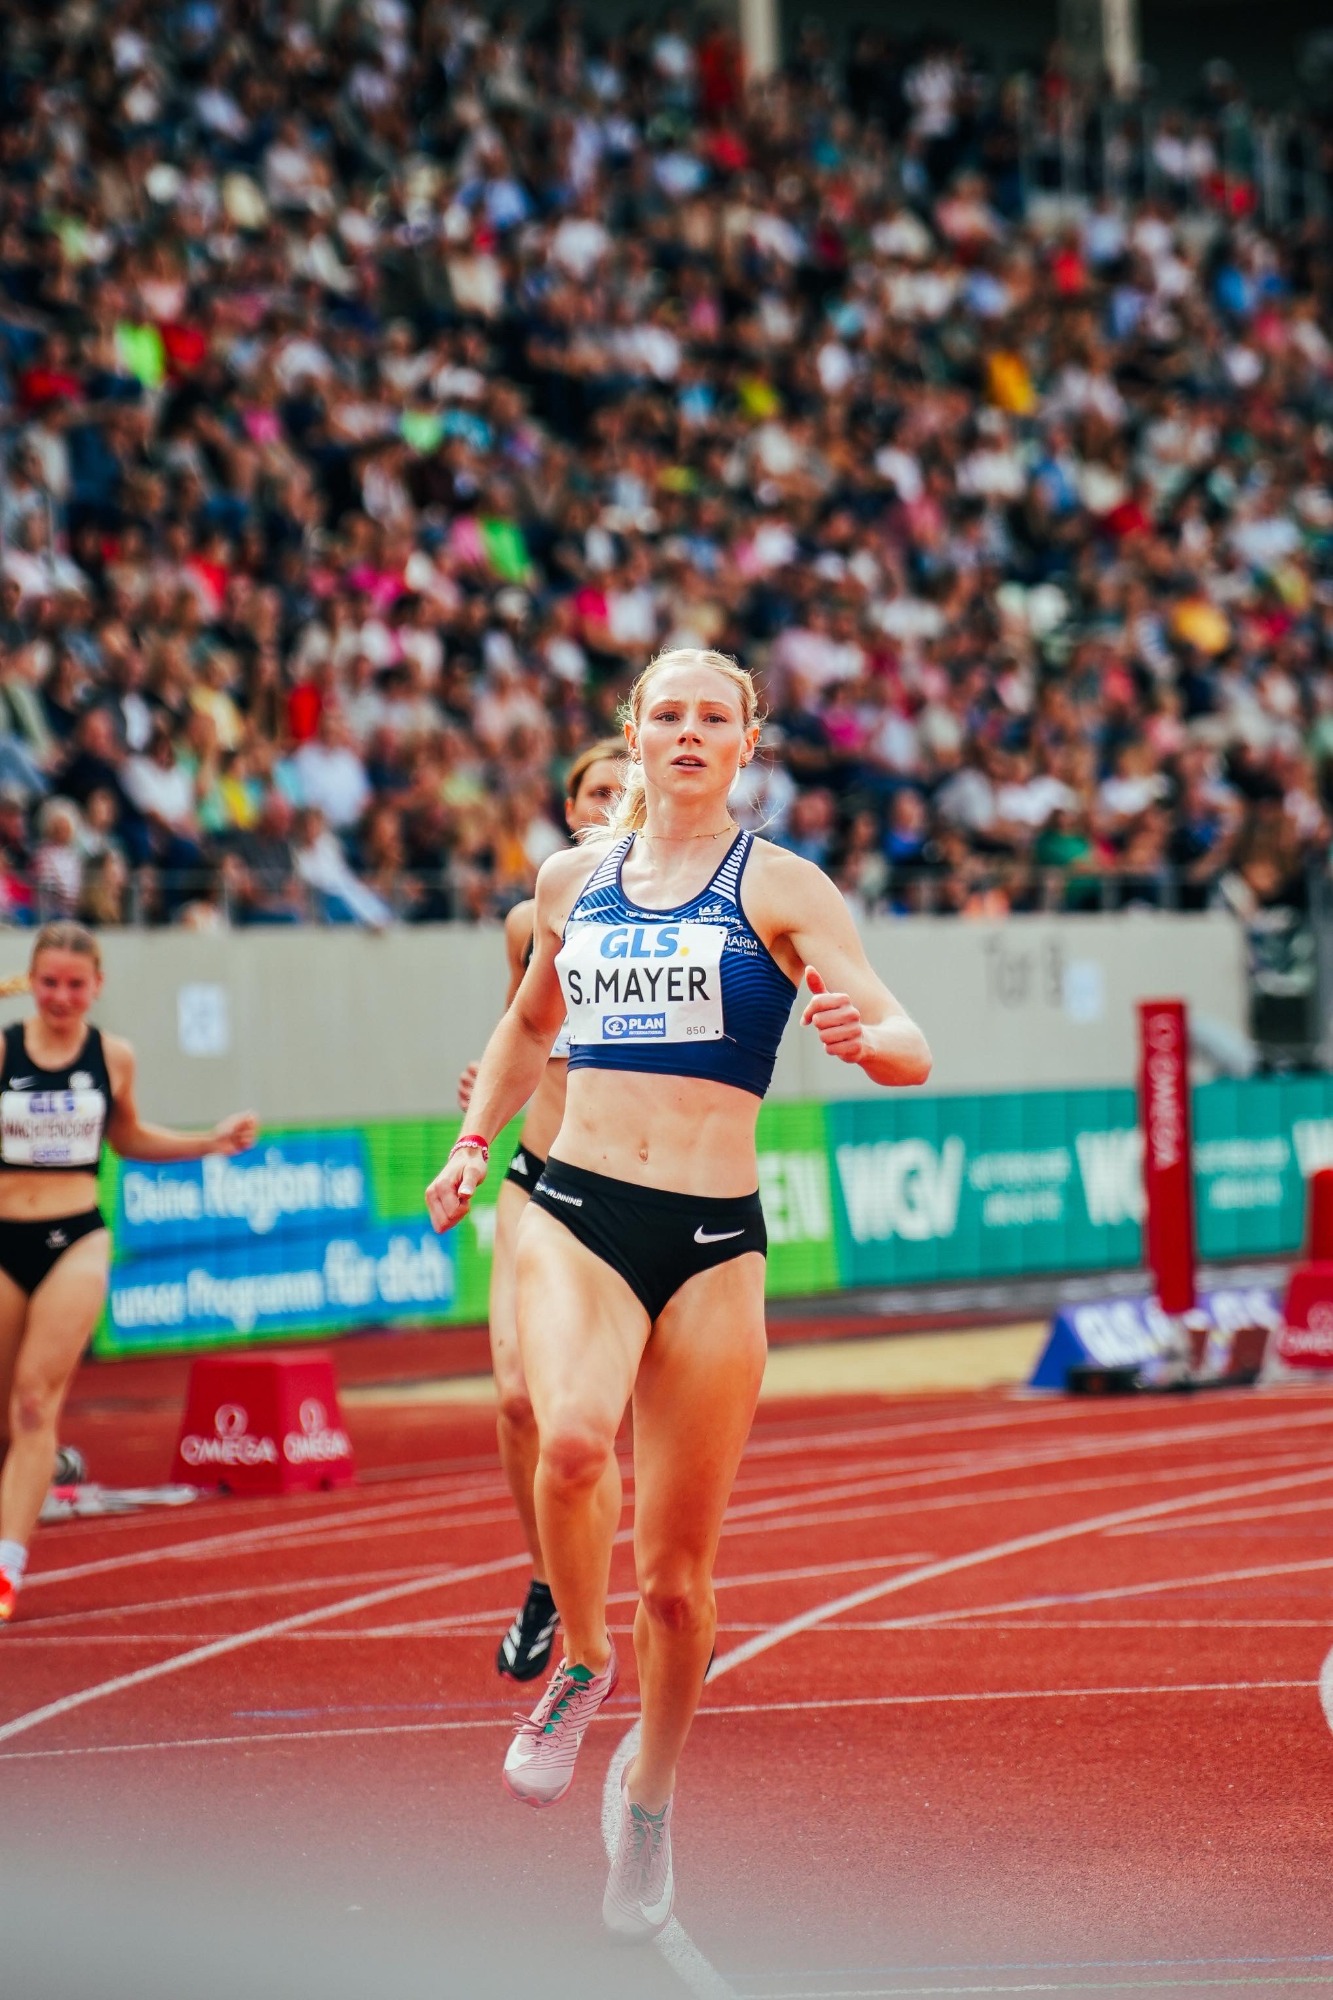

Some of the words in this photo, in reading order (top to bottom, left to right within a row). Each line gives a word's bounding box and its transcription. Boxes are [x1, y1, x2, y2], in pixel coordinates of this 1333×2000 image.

[567, 966, 711, 1006] S.MAYER
[628, 1017, 664, 1030] PLAN
[686, 1025, 706, 1036] 850
[202, 1152, 323, 1235] Region
[112, 1283, 187, 1328] unser
[187, 1267, 325, 1333] Programm
[180, 1434, 279, 1466] OMEGA
[283, 1428, 351, 1465] OMEGA
